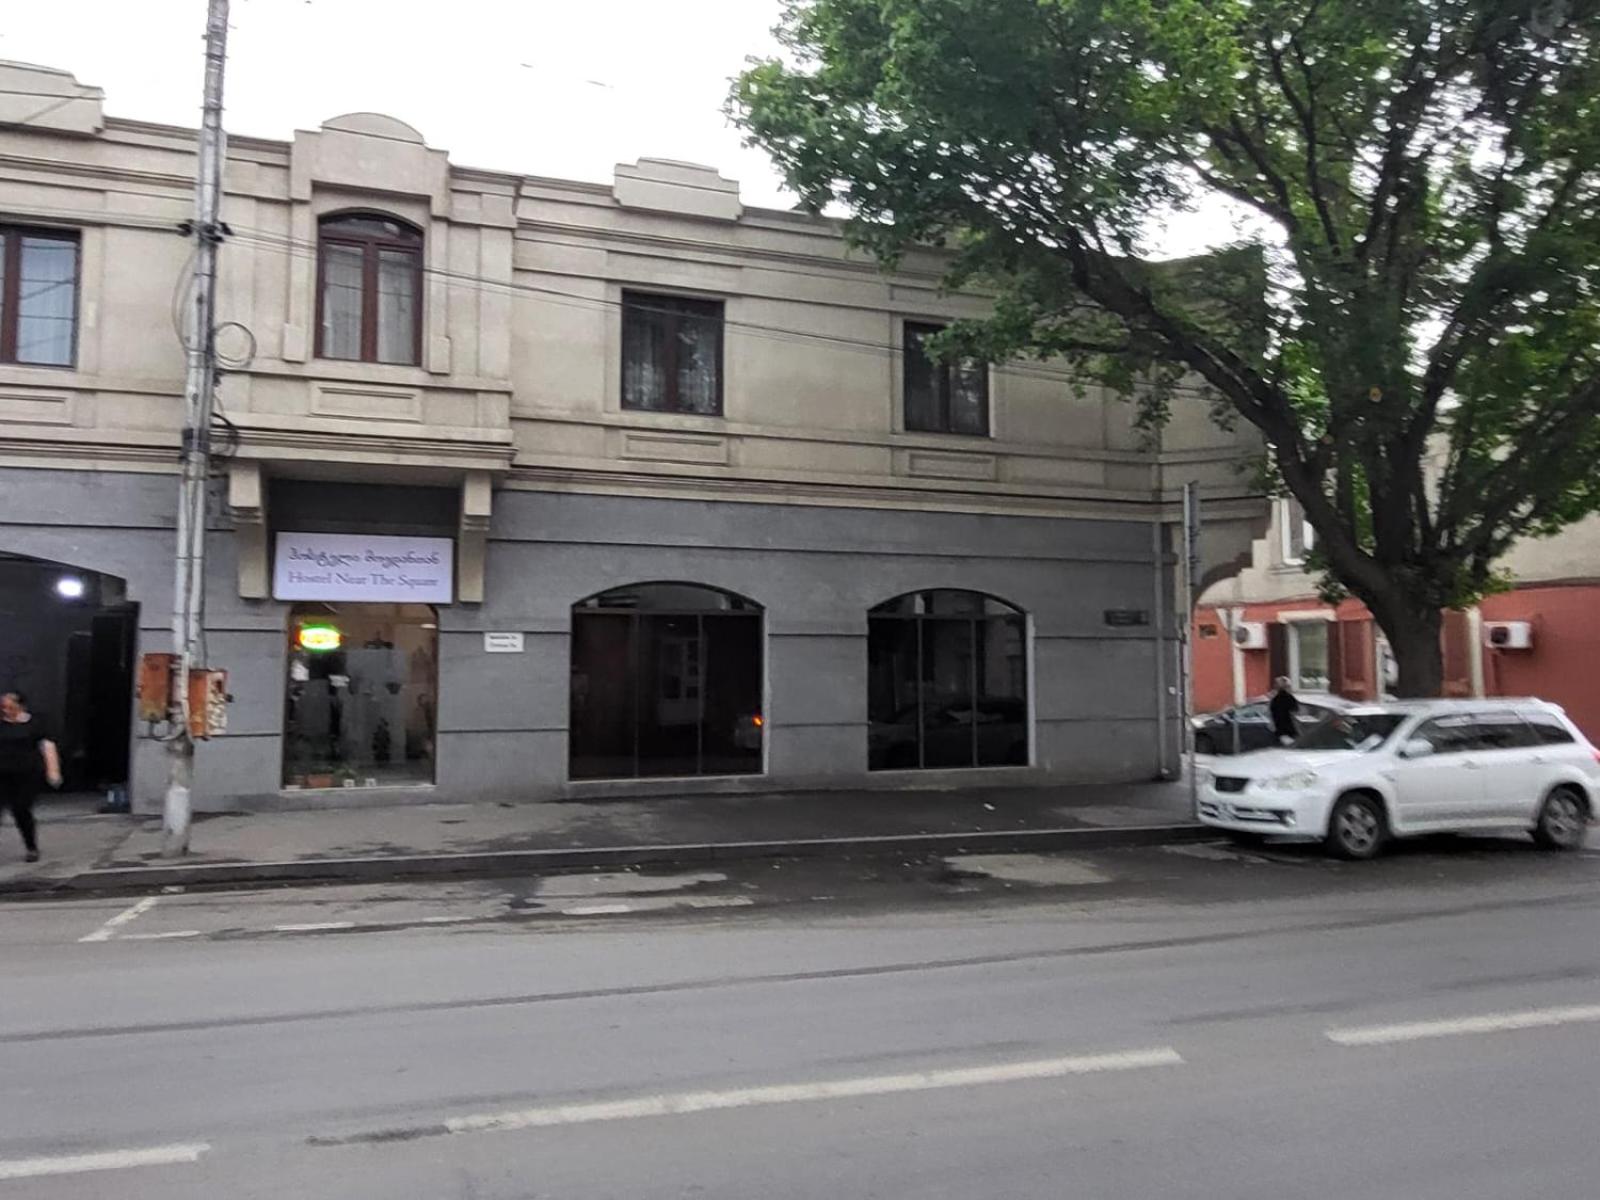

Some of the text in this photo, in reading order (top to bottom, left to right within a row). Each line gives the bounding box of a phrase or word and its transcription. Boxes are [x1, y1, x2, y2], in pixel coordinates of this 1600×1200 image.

[288, 570, 439, 589] Hostel Near The Square
